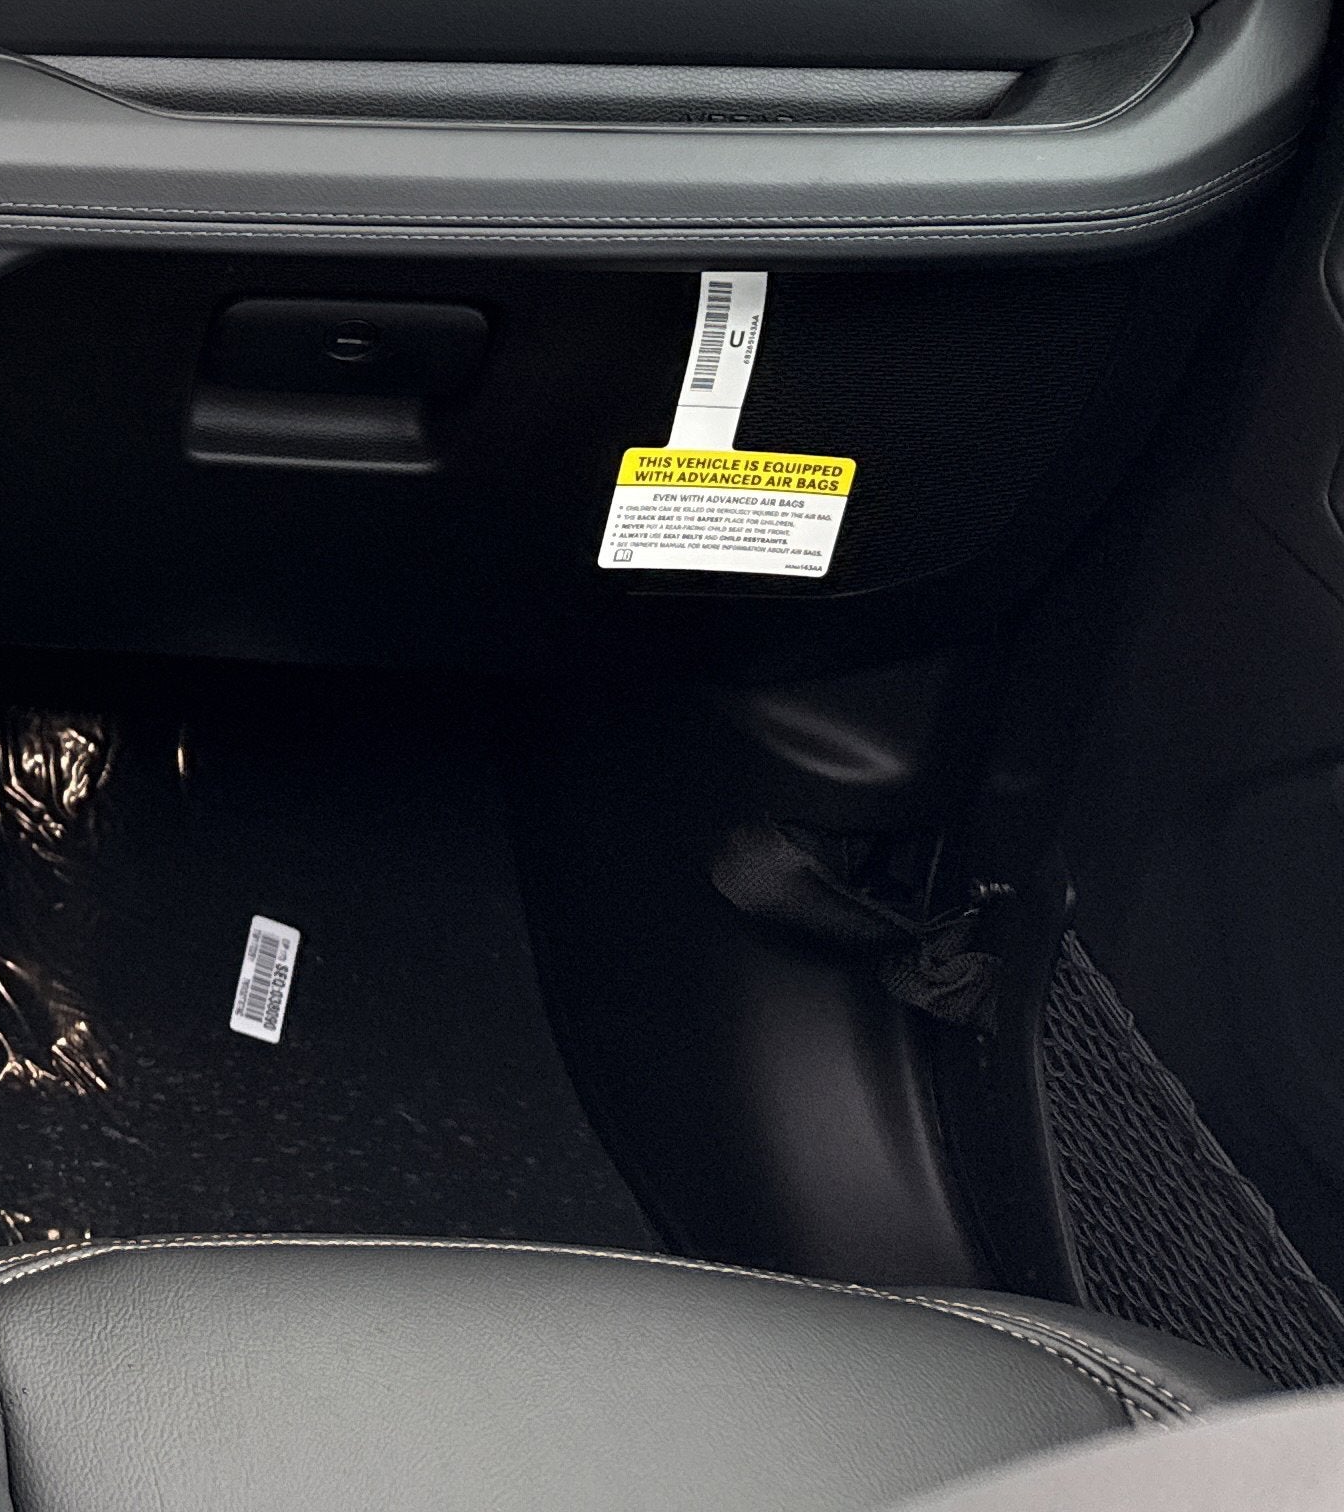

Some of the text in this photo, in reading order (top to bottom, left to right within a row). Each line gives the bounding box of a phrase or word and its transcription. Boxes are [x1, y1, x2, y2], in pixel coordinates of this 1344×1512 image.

[729, 330, 746, 348] U
[638, 456, 843, 478] THIS VEHICLE IS EQUIPPED
[635, 471, 840, 492] WITH ADVANCED AIR BAGS
[653, 494, 805, 508] EVEN WITH ADVANCED AIR BAGS
